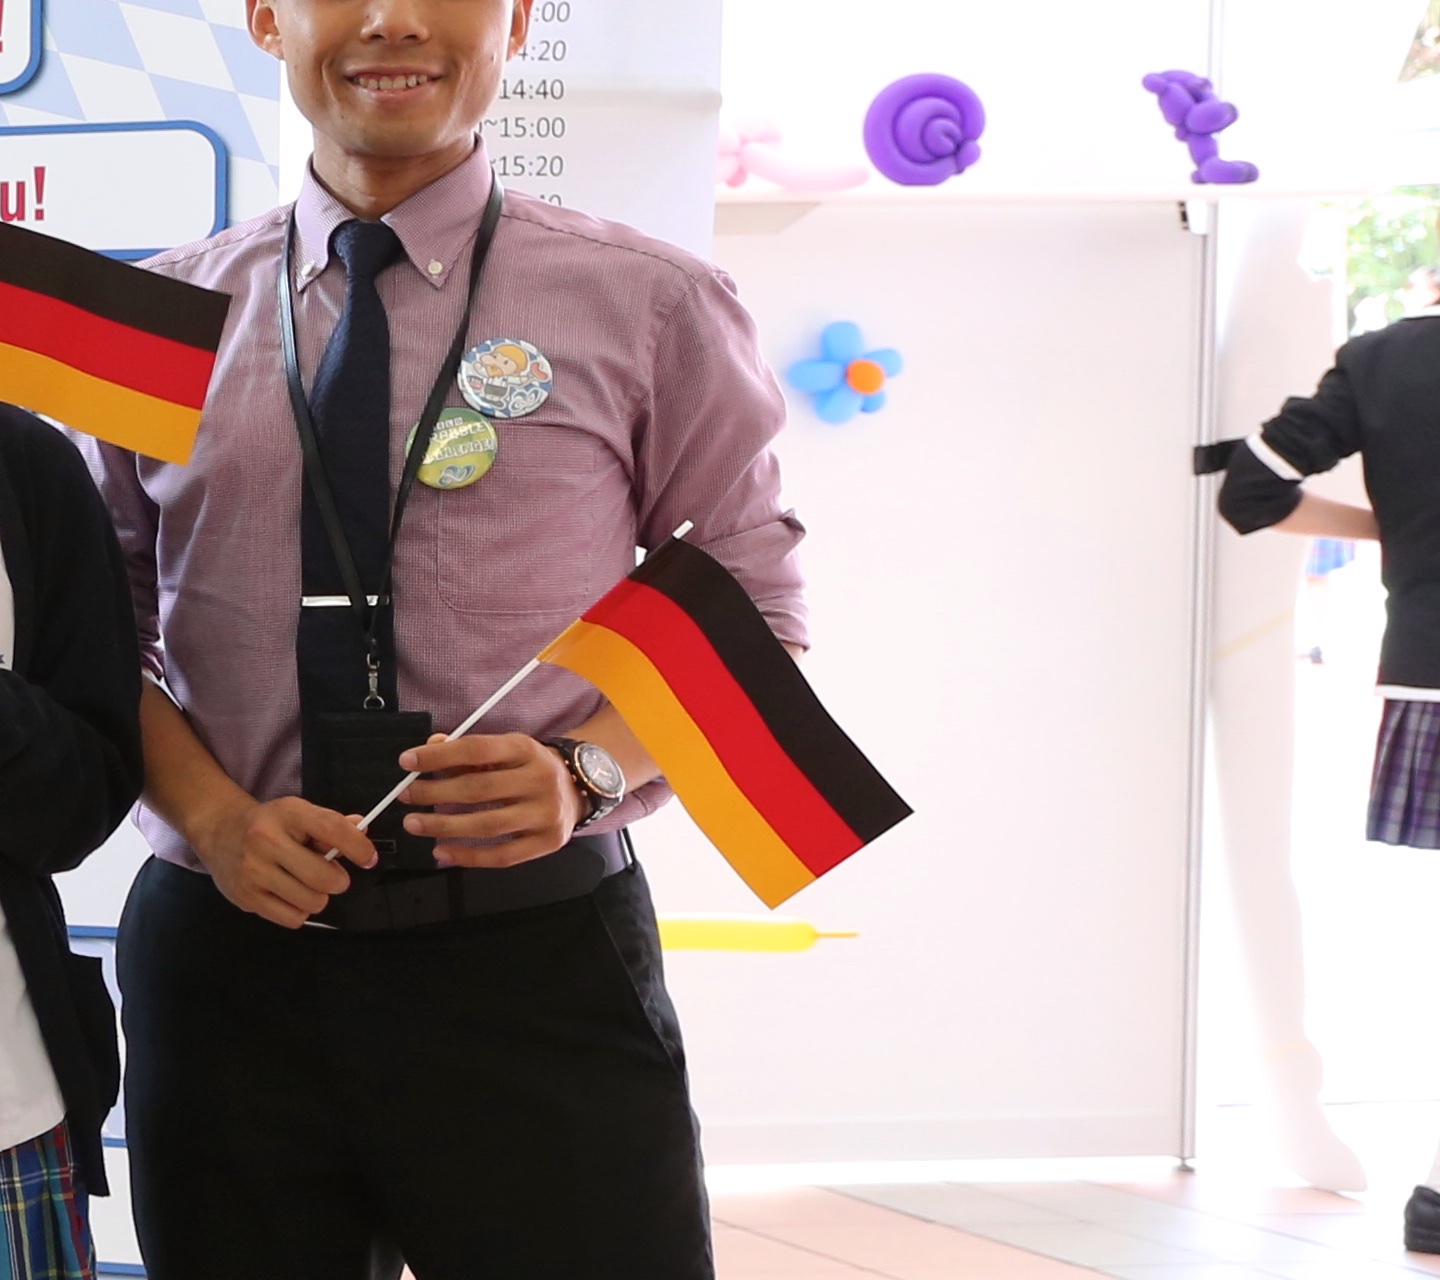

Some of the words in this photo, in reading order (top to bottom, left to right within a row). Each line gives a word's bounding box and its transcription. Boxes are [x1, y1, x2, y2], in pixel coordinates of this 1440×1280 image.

[534, 1, 570, 22] :00
[517, 40, 567, 61] 4:20
[498, 79, 564, 100] 14:40
